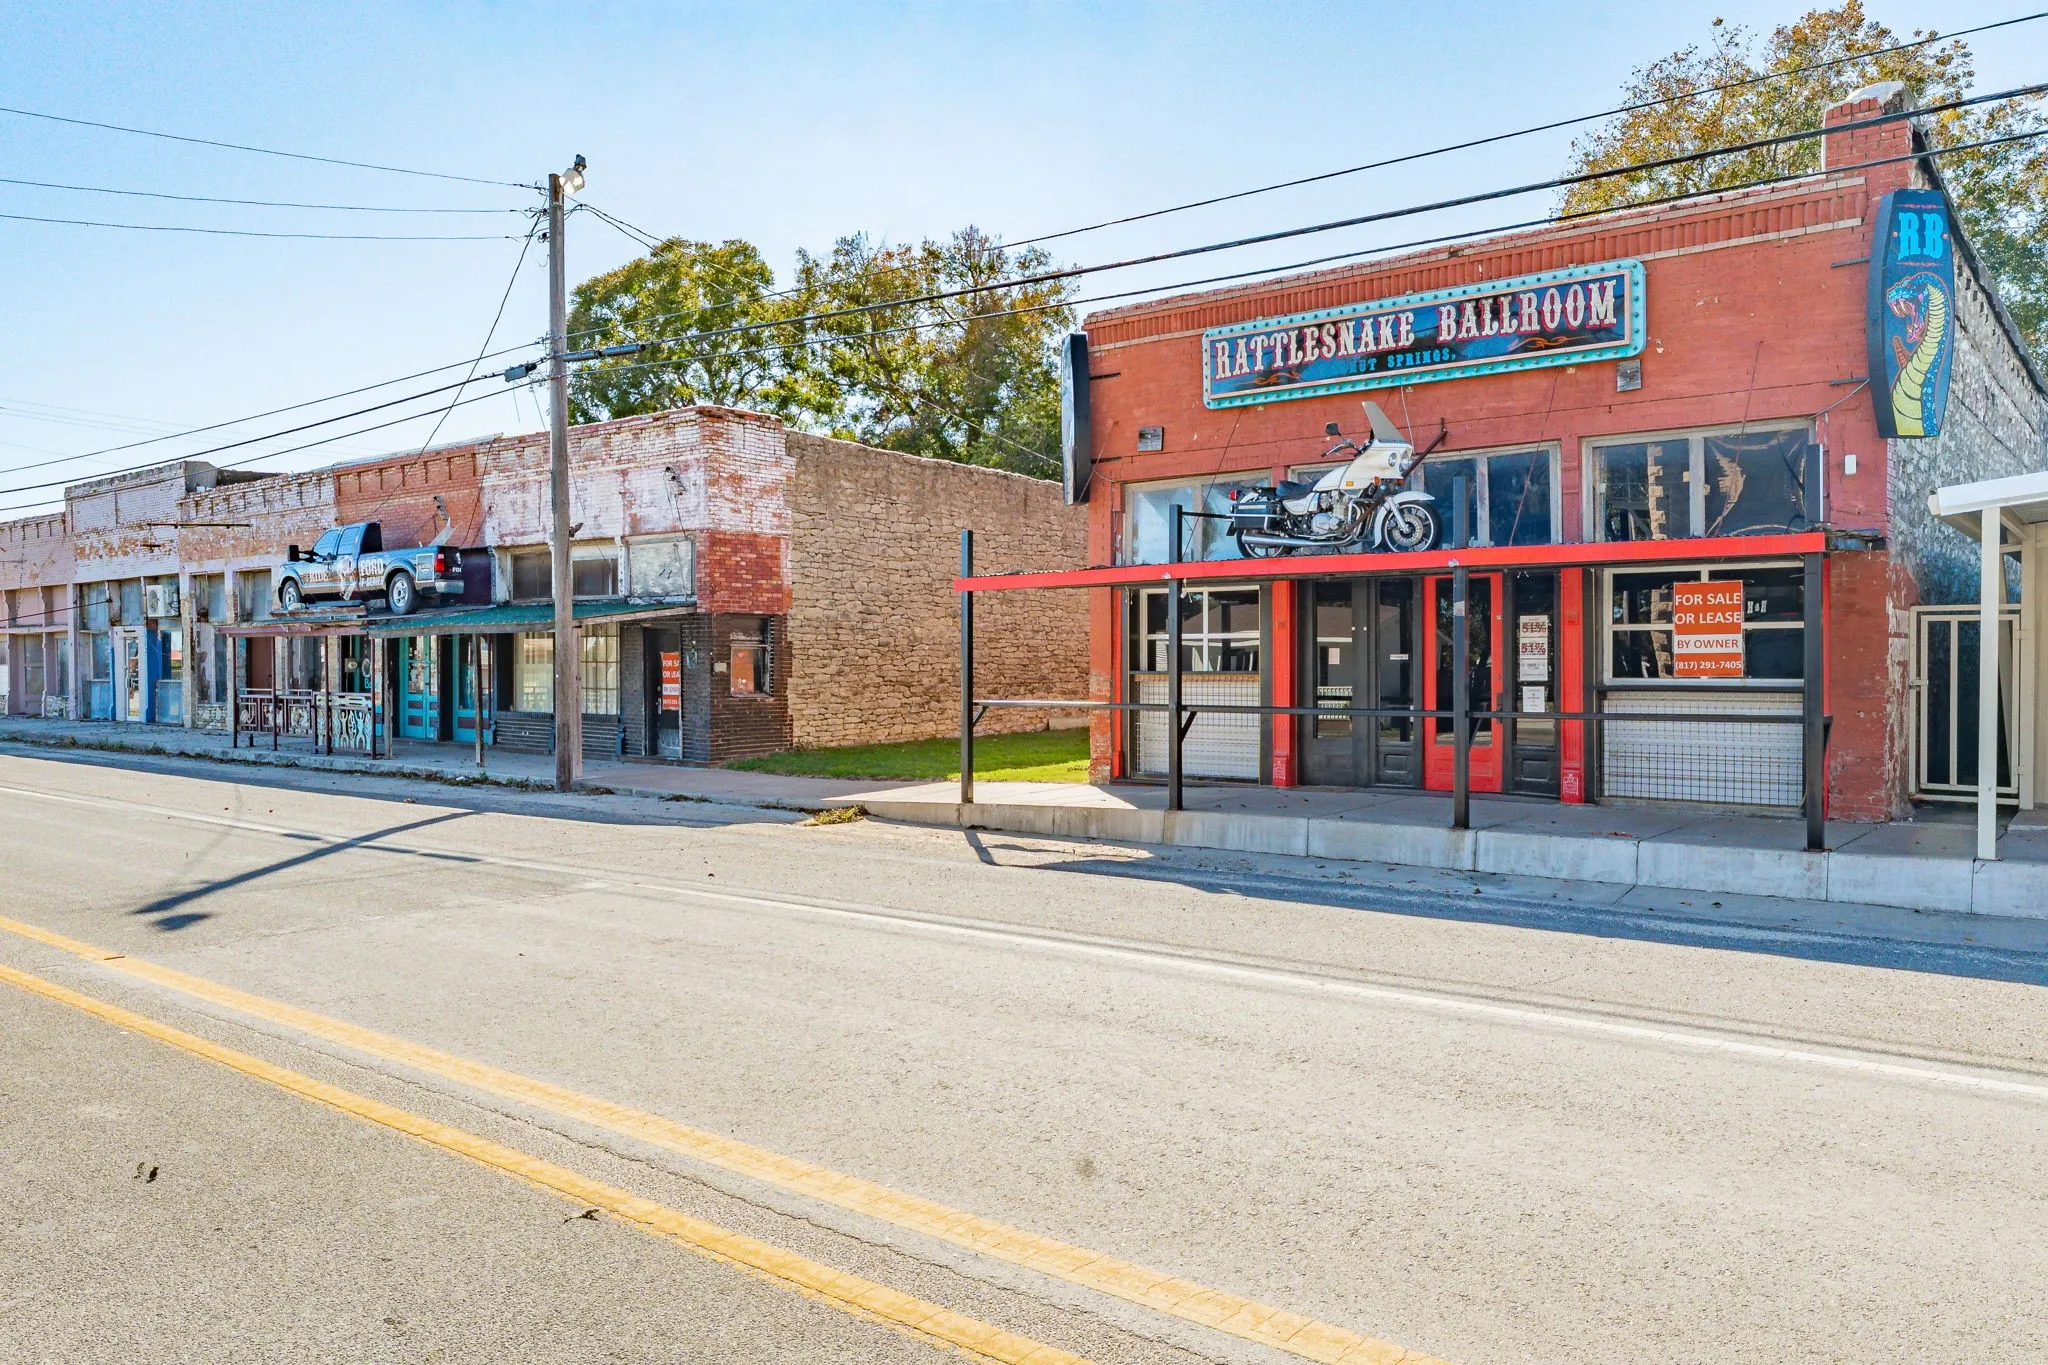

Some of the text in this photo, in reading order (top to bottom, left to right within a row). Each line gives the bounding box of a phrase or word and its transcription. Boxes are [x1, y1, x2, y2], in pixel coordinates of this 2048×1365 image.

[1898, 212, 1943, 260] RB
[1215, 279, 1617, 380] RATTLESNAKE BALLROOM
[1387, 347, 1456, 369] SPRINGS,
[1675, 592, 1741, 606] FOR SALE
[1675, 611, 1741, 624] OR LEASE
[1677, 638, 1739, 649] BY OWNER
[662, 659, 672, 667] FOR
[1675, 660, 1742, 671] (817) 291-7405
